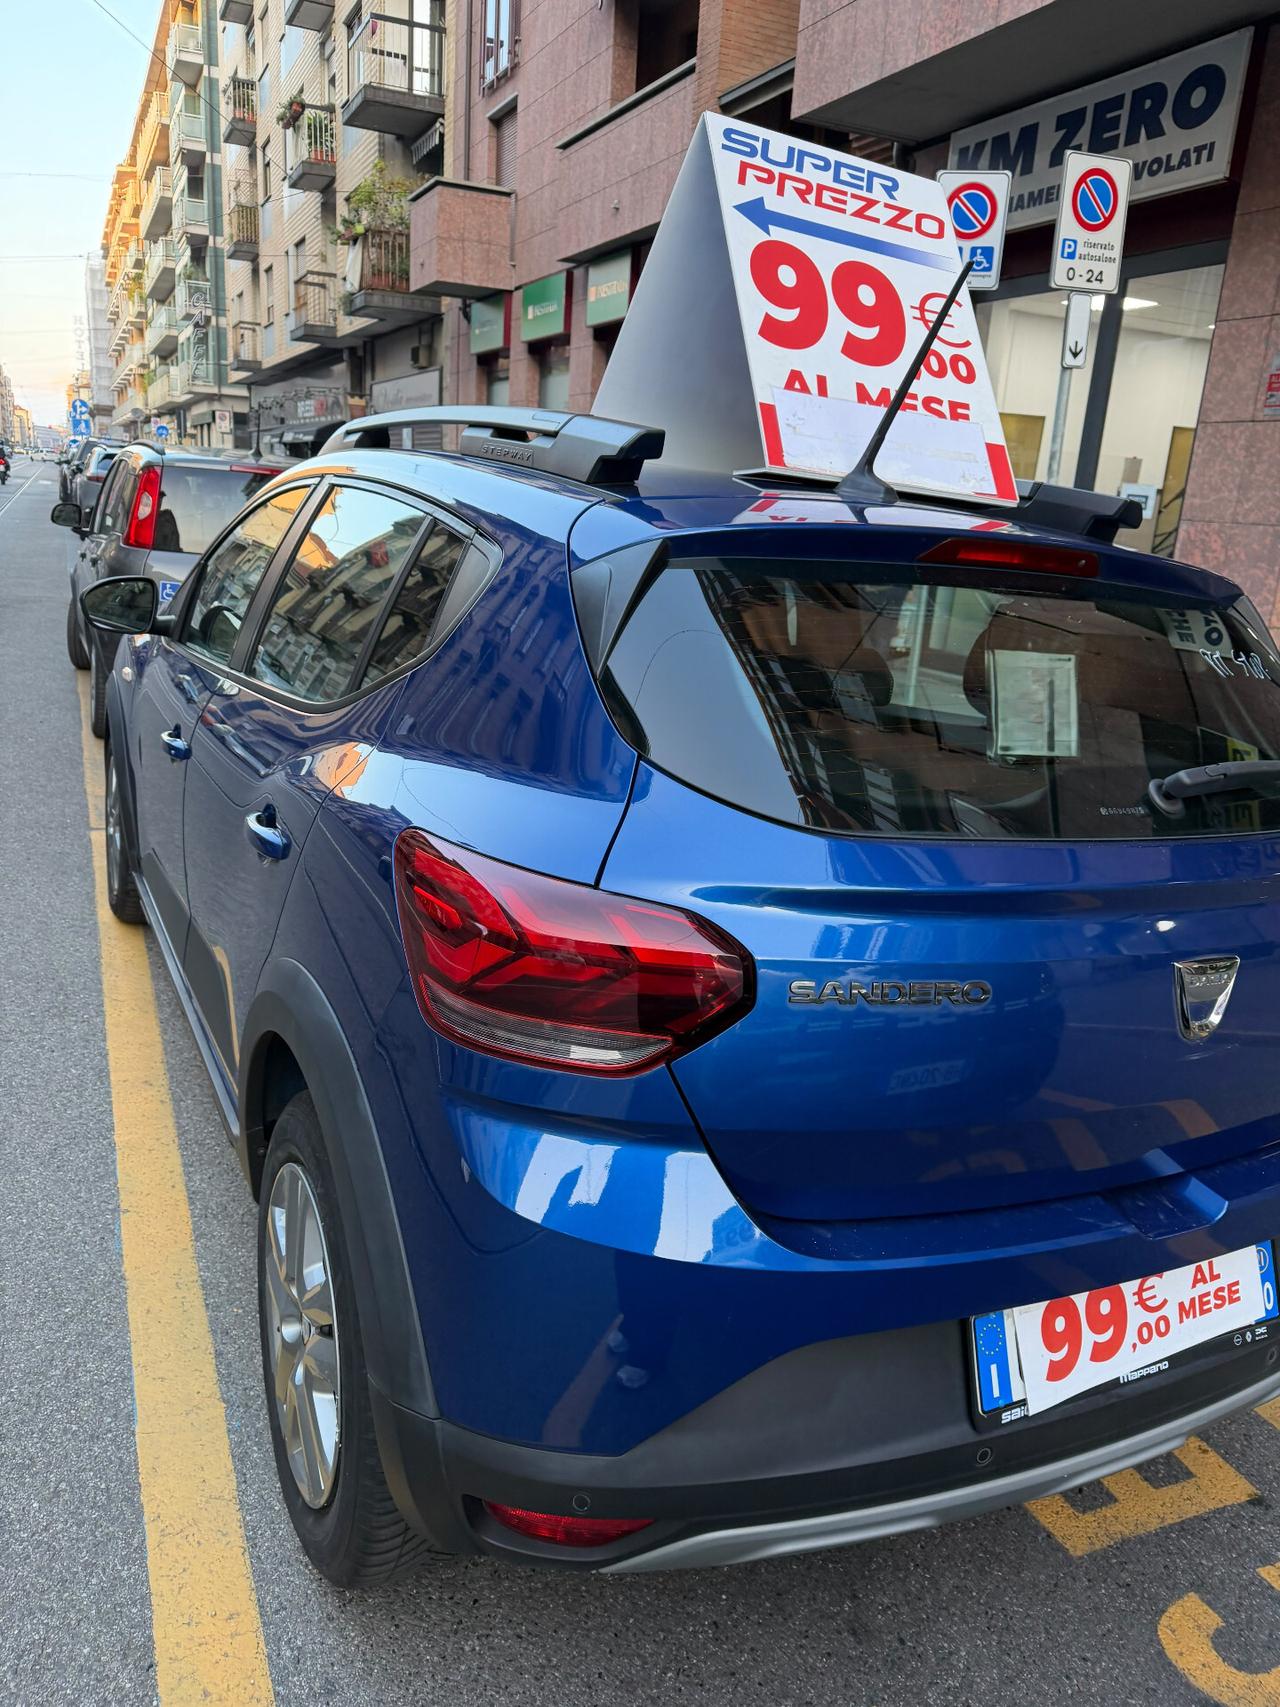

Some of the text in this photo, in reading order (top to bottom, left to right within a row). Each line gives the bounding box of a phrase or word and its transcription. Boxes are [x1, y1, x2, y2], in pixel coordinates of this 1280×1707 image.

[956, 63, 1227, 177] KM ZERO
[721, 127, 900, 201] SUPER
[738, 159, 945, 240] PREZZO
[1078, 252, 1117, 264] autosalone
[1083, 238, 1115, 252] riservato
[750, 239, 906, 367] 99
[482, 446, 534, 461] STEPWAY
[788, 980, 992, 1005] SANDERO
[1191, 1260, 1222, 1289] AL
[1041, 1283, 1128, 1382] 99
[1178, 1280, 1241, 1325] MESE
